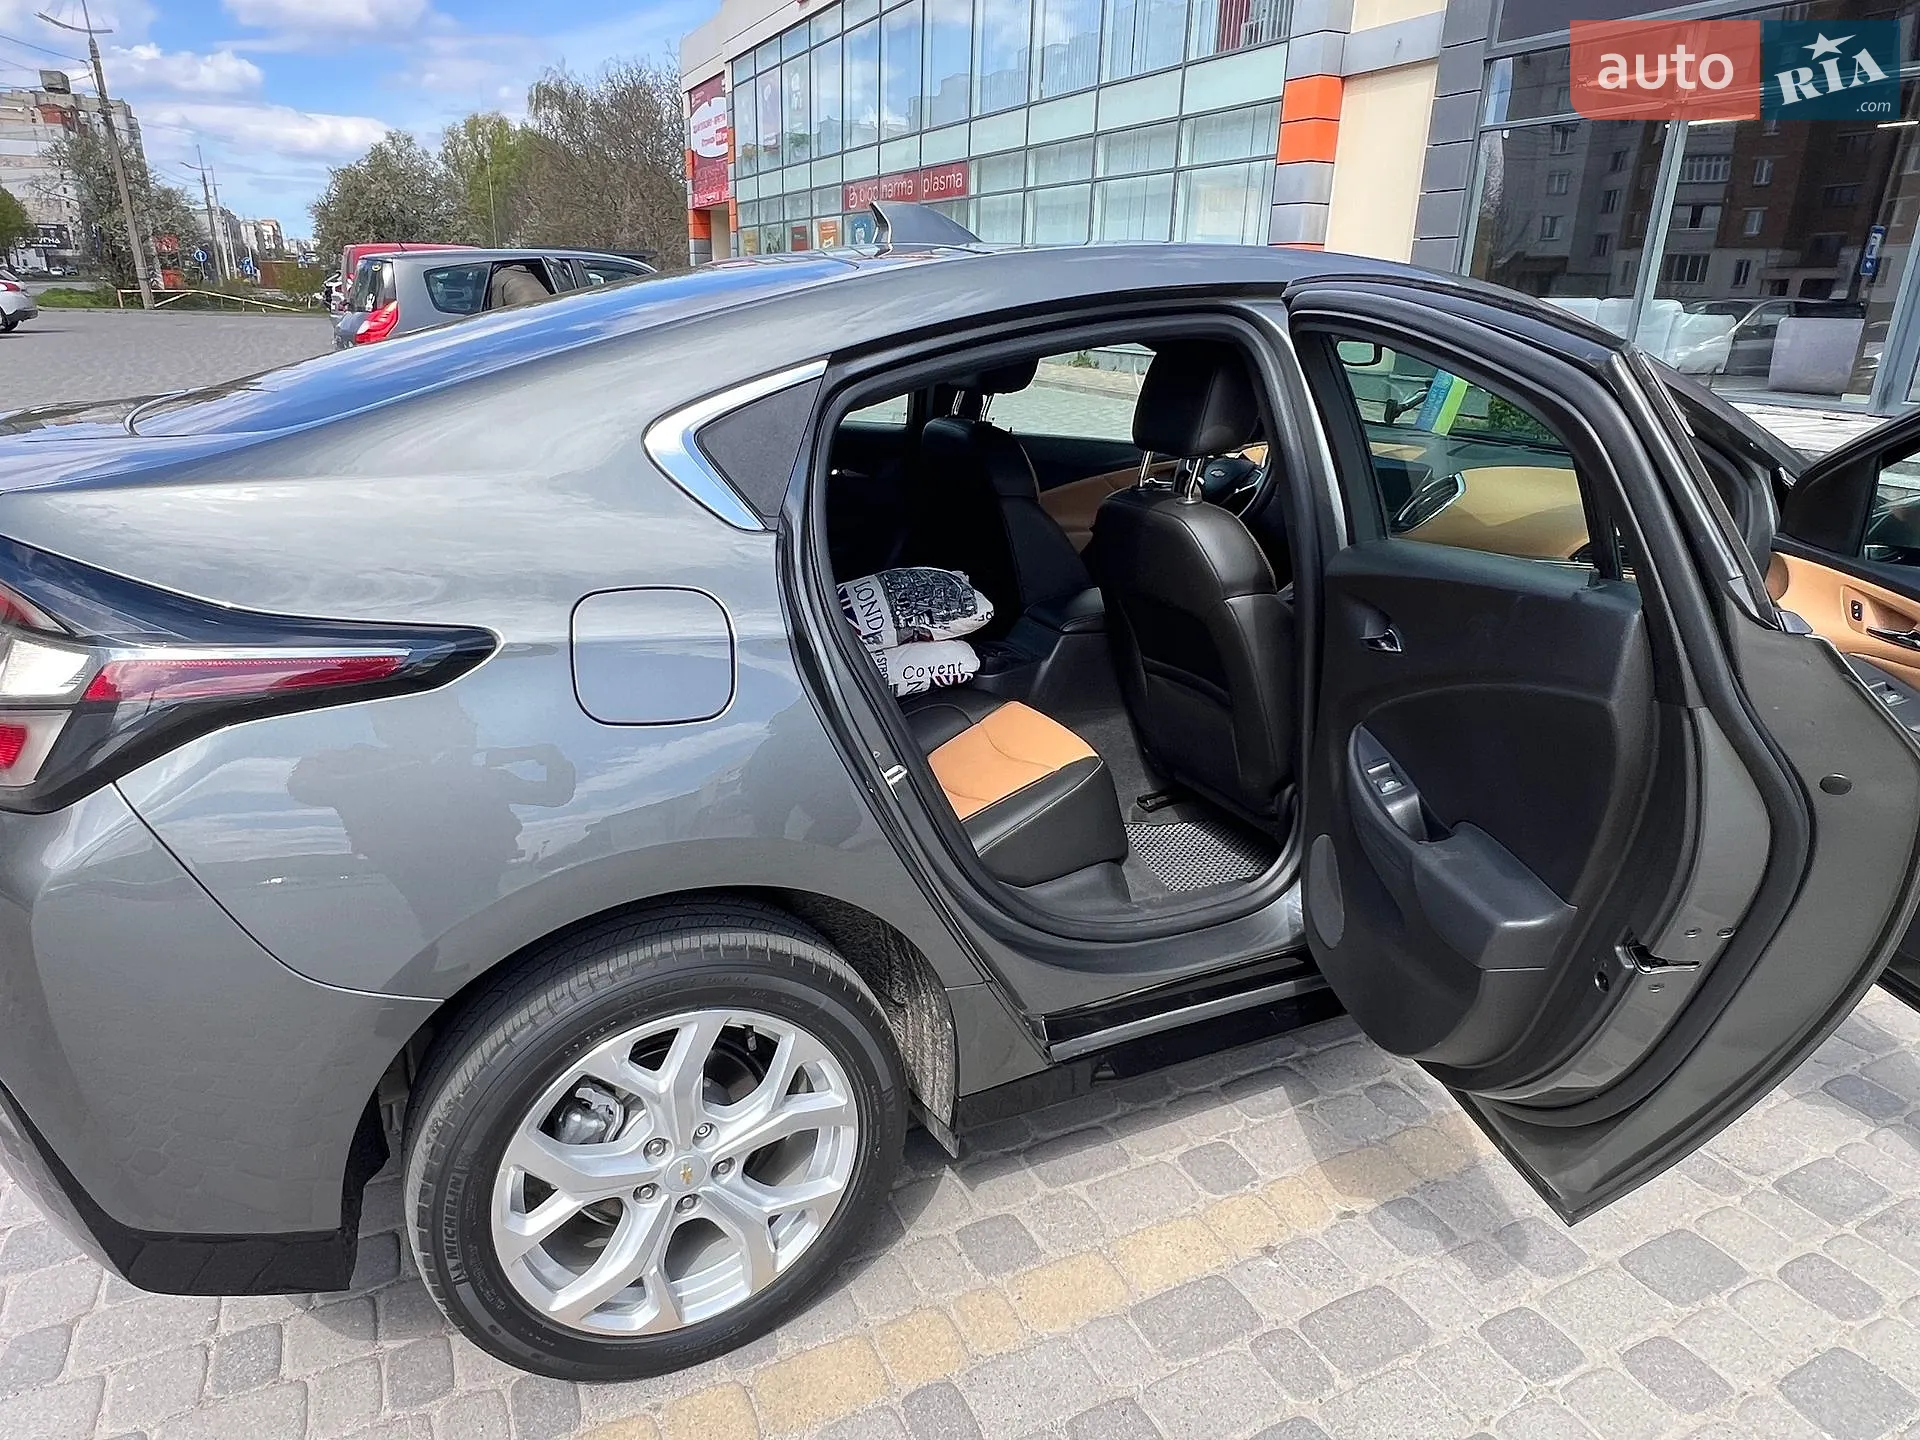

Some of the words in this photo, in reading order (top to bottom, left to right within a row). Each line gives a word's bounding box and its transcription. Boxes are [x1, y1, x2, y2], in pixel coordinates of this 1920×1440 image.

[923, 171, 963, 199] plasma
[902, 661, 963, 680] Covent
[443, 1176, 462, 1260] MICHELIN
